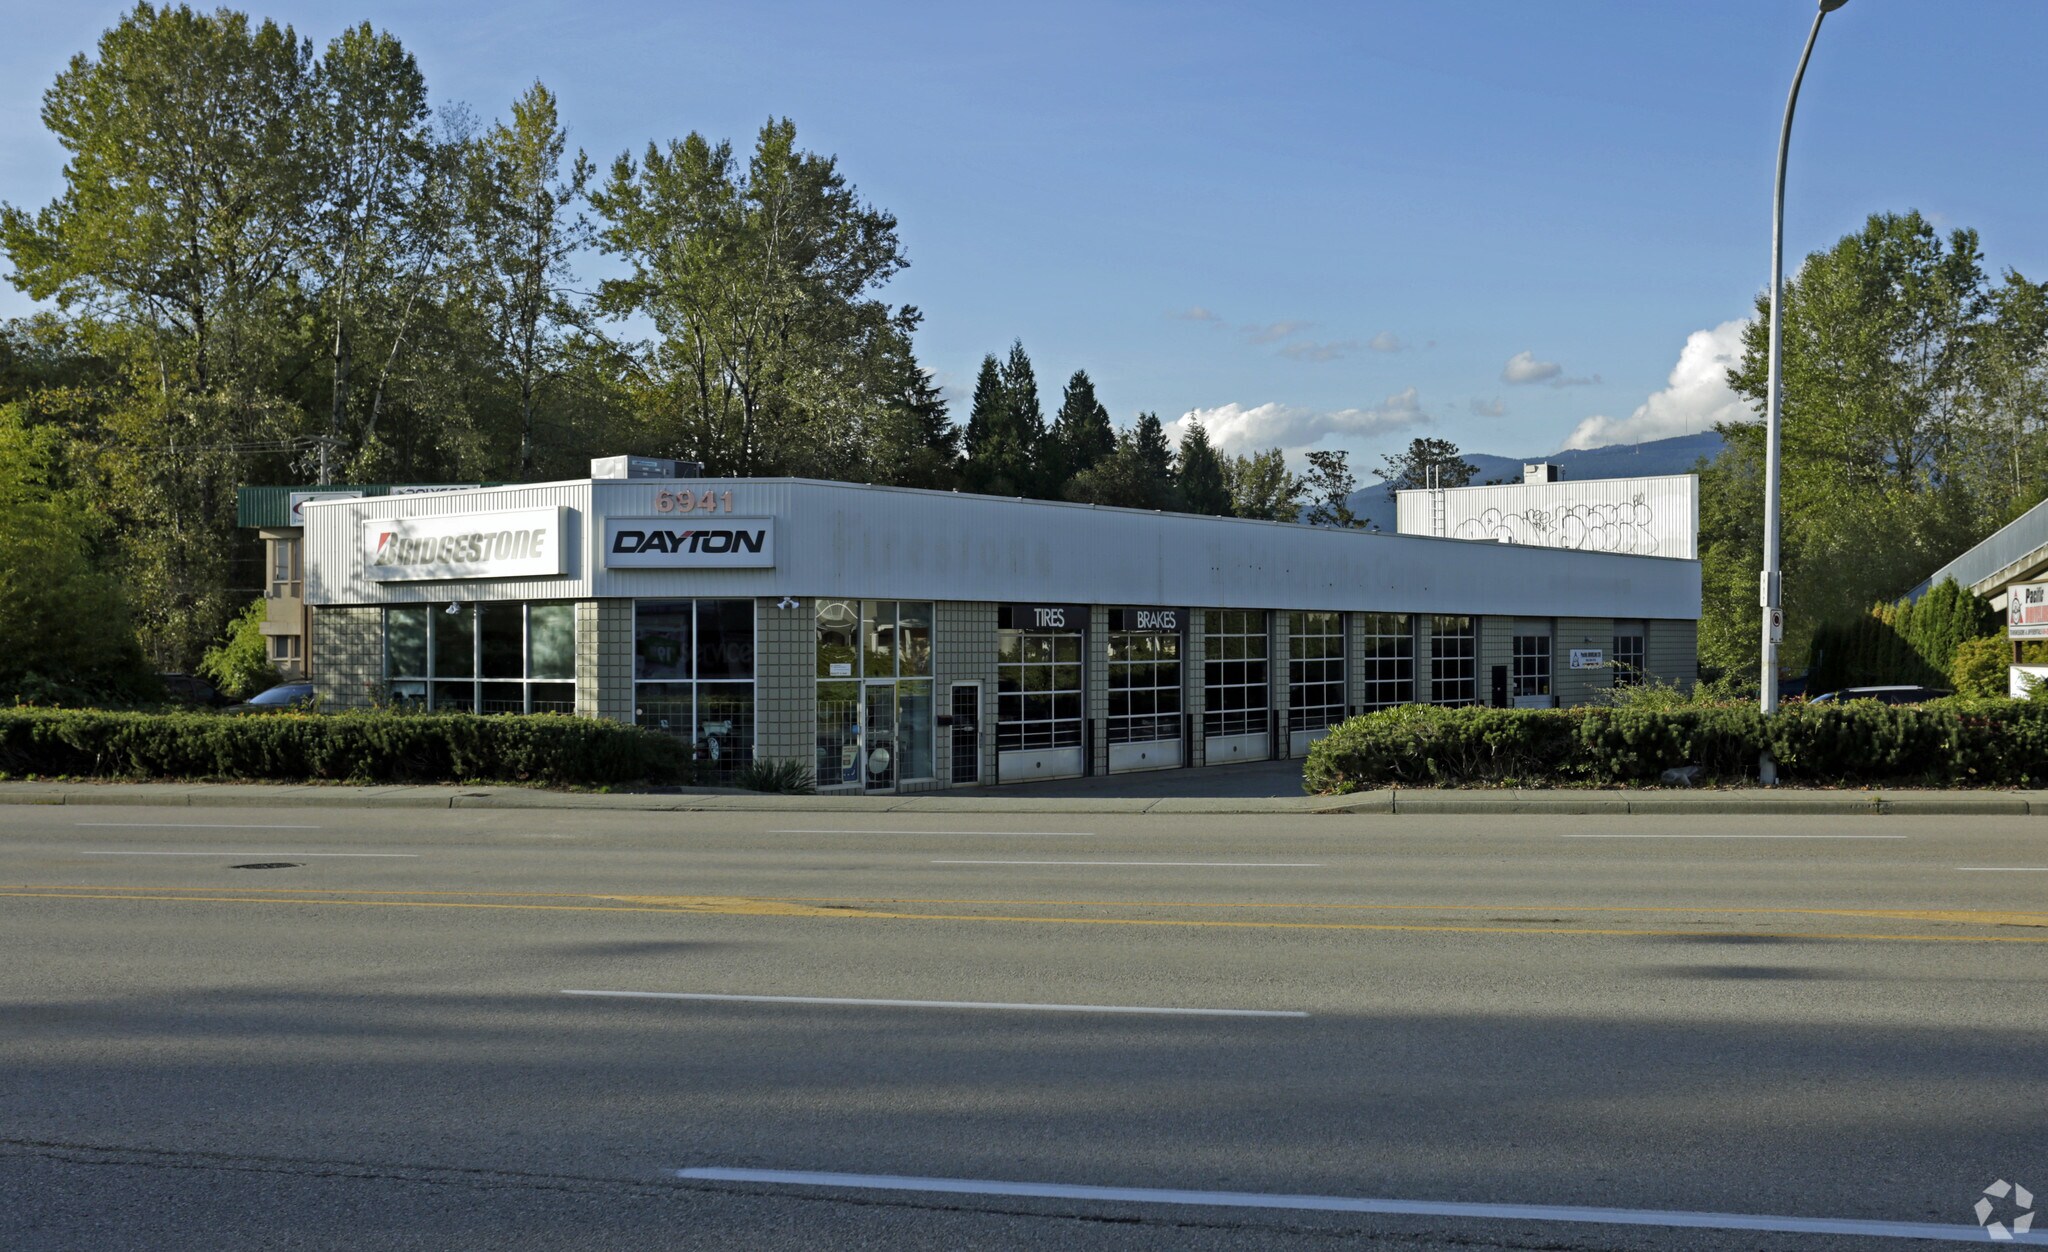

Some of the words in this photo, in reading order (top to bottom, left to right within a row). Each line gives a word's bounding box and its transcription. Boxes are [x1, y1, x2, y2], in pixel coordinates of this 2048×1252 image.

[655, 489, 733, 513] 6941
[374, 529, 547, 567] BRIDGESTONE
[612, 530, 766, 554] DAYTON
[1034, 608, 1065, 627] TIRES
[1137, 611, 1176, 629] BRAKES
